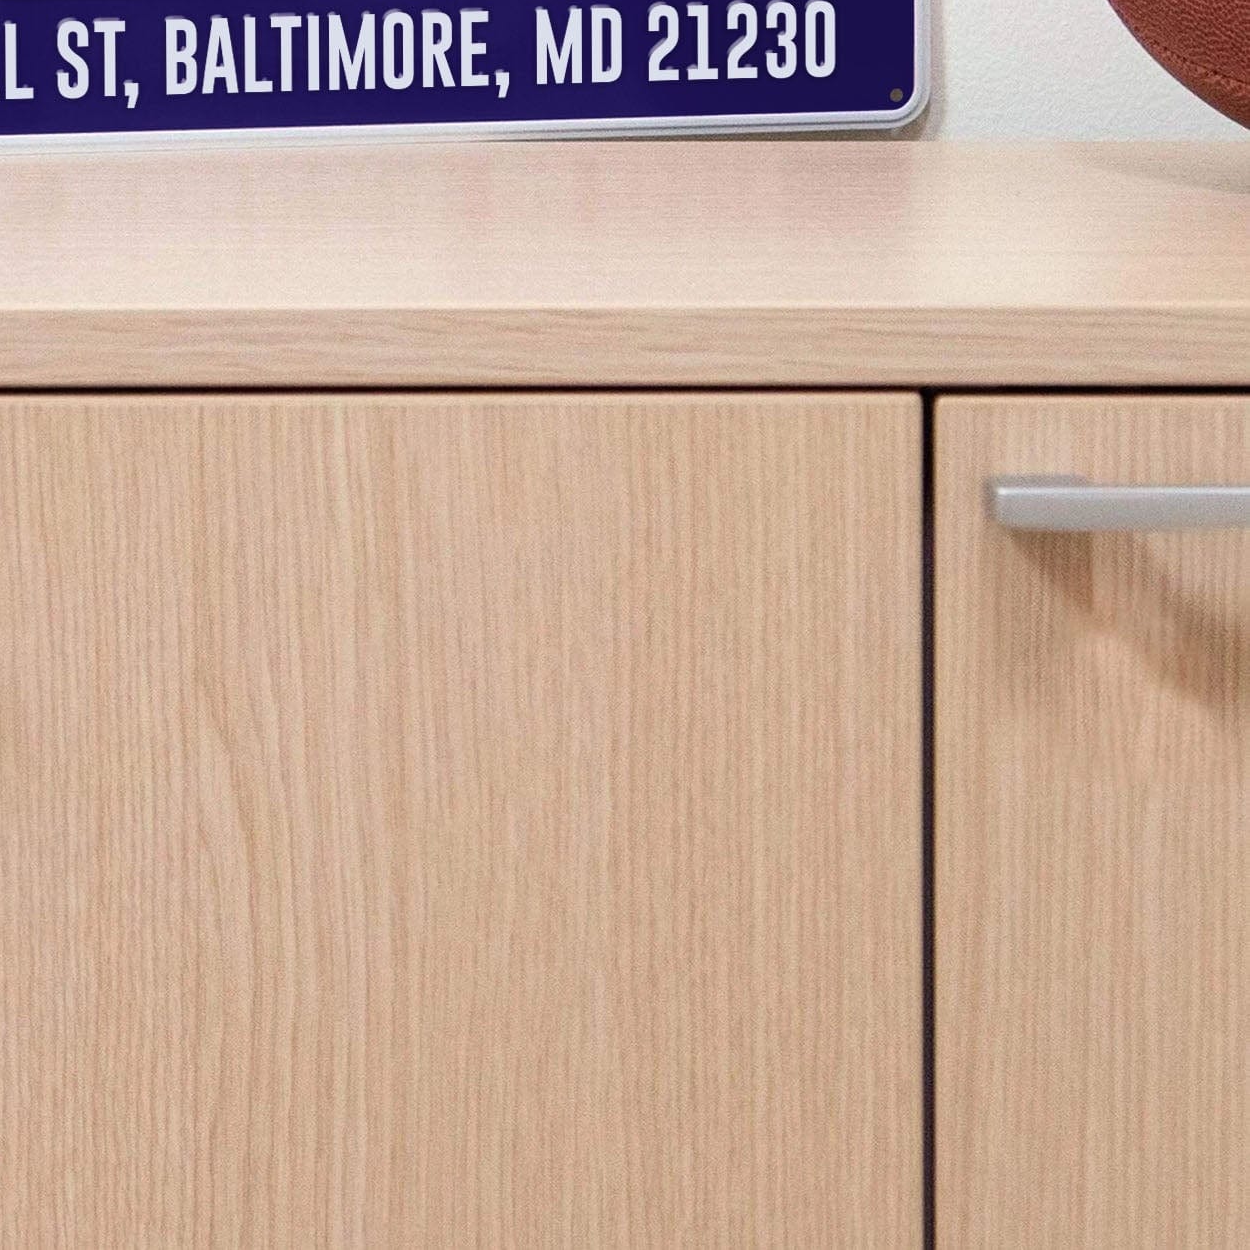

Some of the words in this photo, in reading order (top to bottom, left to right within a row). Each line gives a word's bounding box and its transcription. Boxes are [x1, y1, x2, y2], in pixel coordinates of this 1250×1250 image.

[57, 20, 138, 108] ST,
[166, 10, 509, 97] BALTIMORE,
[536, 6, 622, 84] MD
[649, 0, 835, 81] 21230
